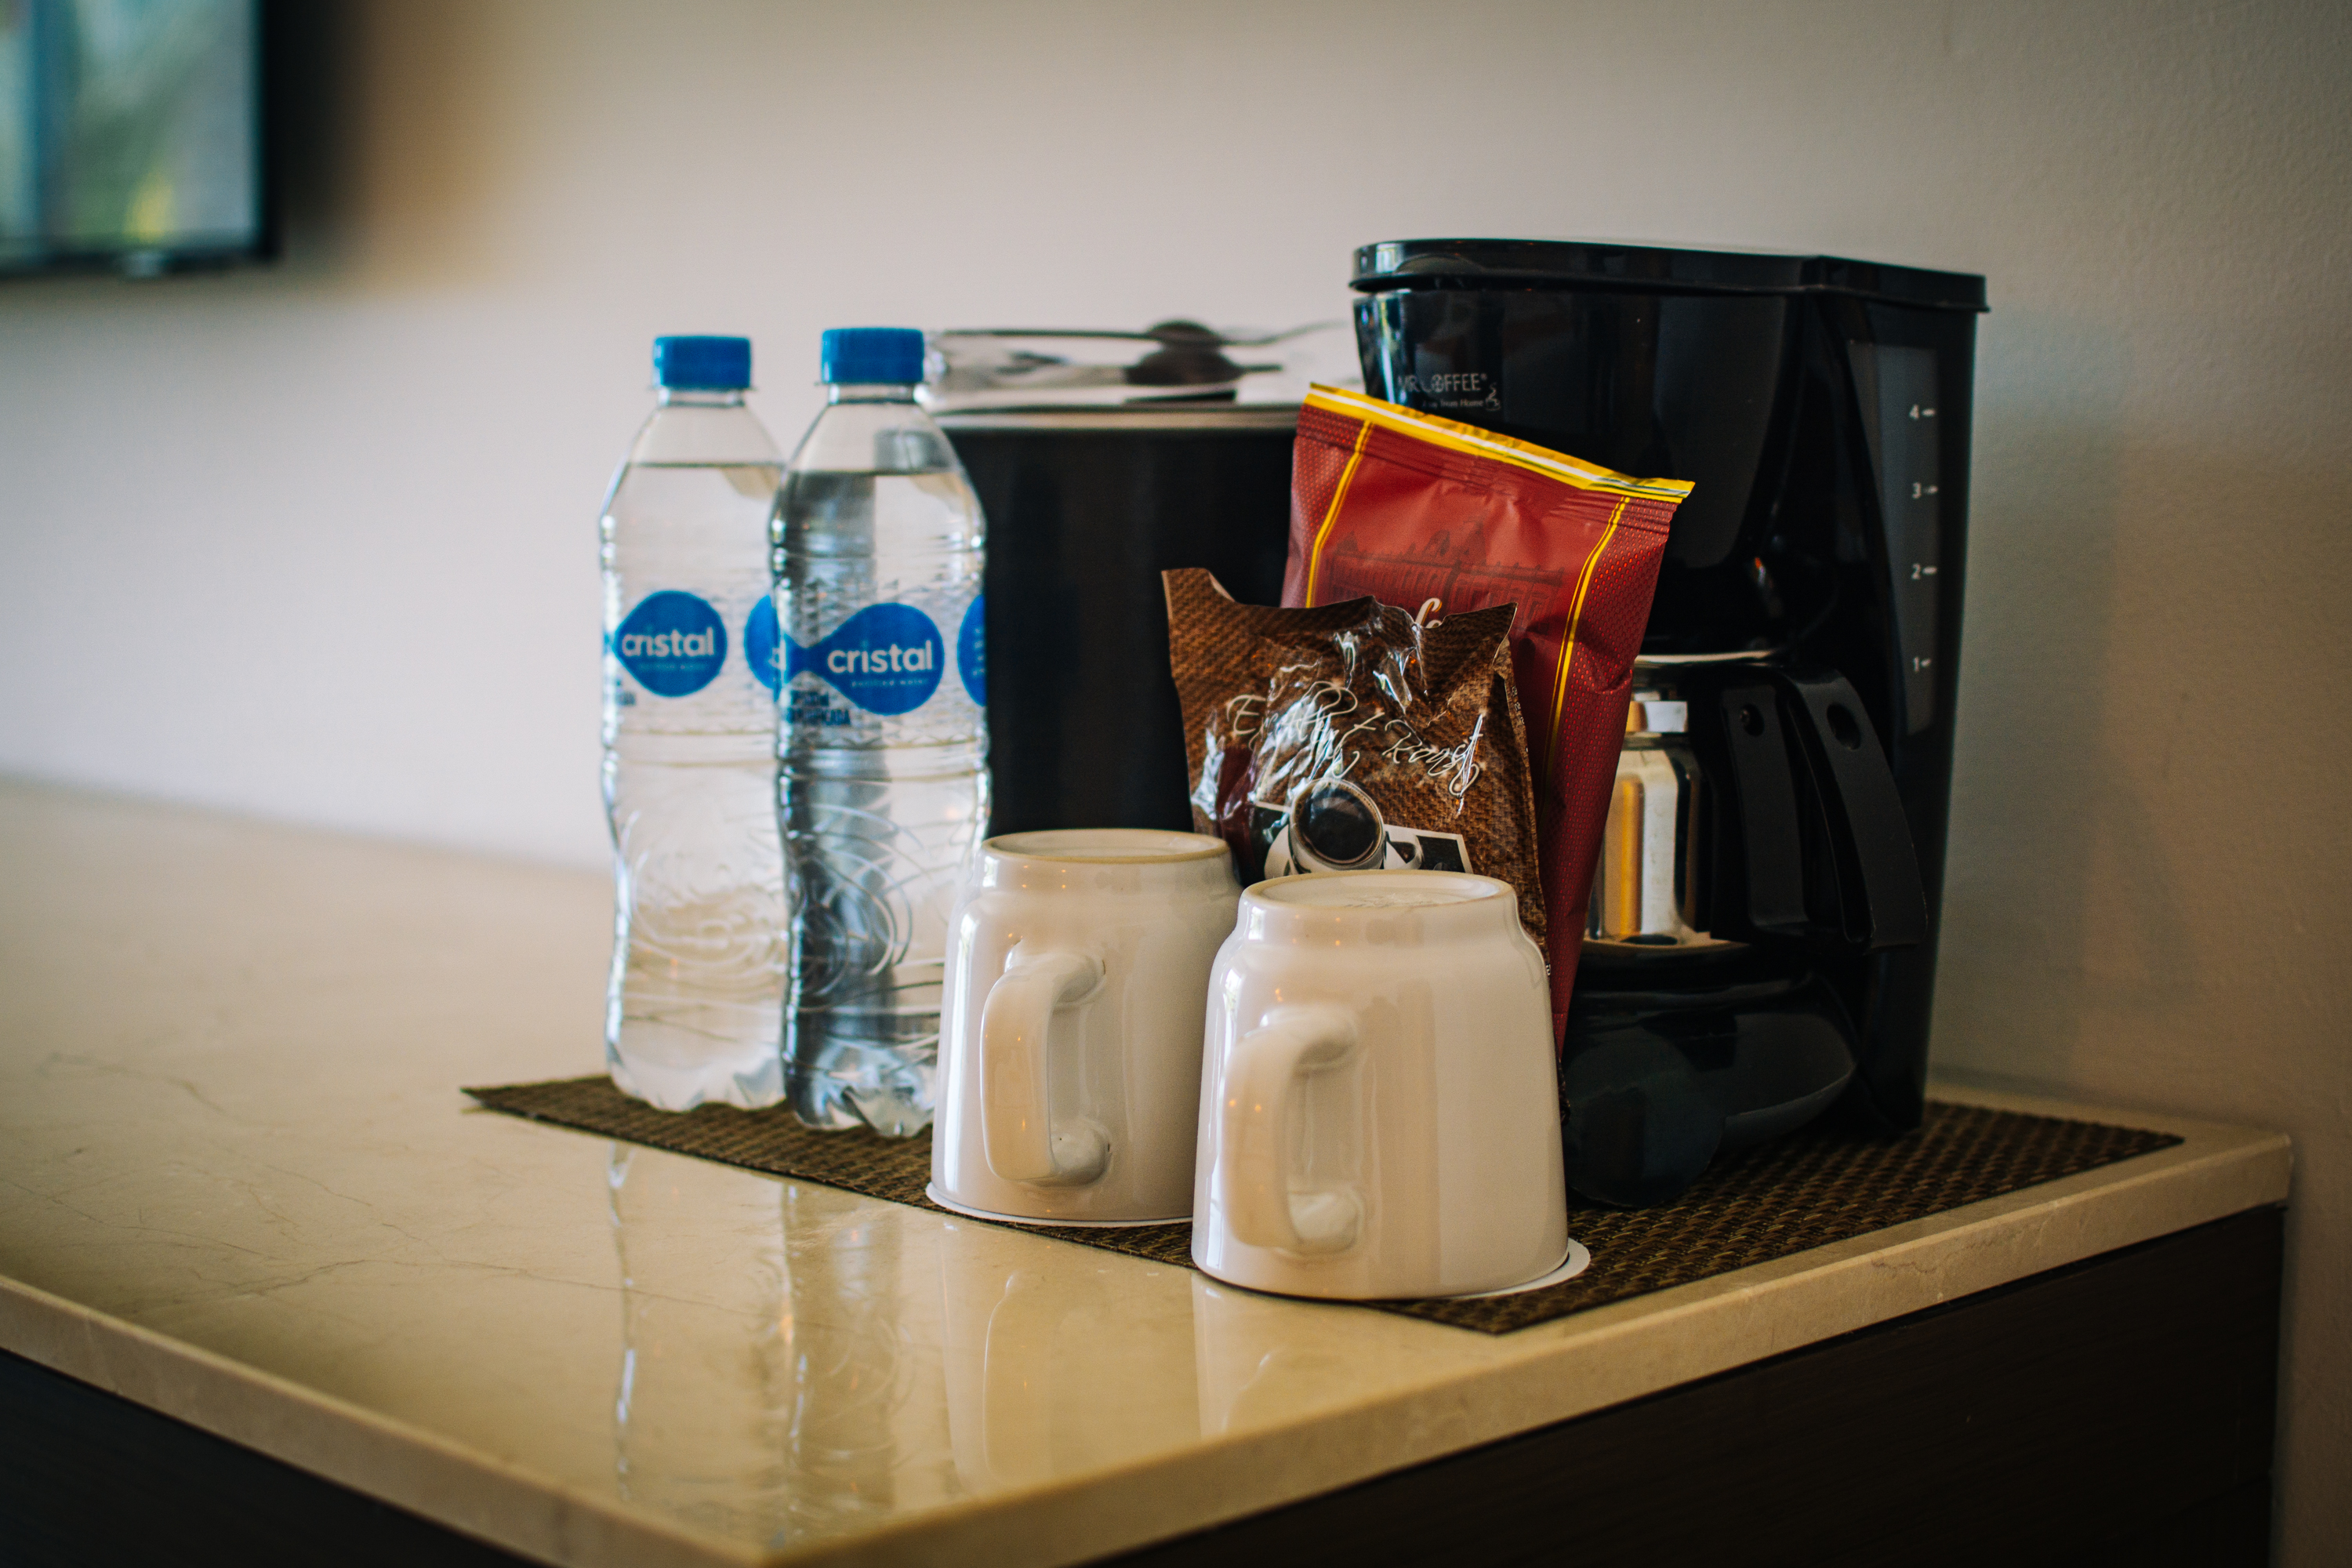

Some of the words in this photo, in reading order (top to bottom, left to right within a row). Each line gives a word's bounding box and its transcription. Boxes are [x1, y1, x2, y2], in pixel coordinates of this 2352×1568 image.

[1909, 404, 1920, 419] 4
[1911, 482, 1922, 499] 3
[1911, 563, 1921, 579] 2
[621, 626, 716, 658] cristal
[827, 639, 933, 673] cristal
[1913, 656, 1920, 672] 1
[1226, 680, 1385, 779] Exllent
